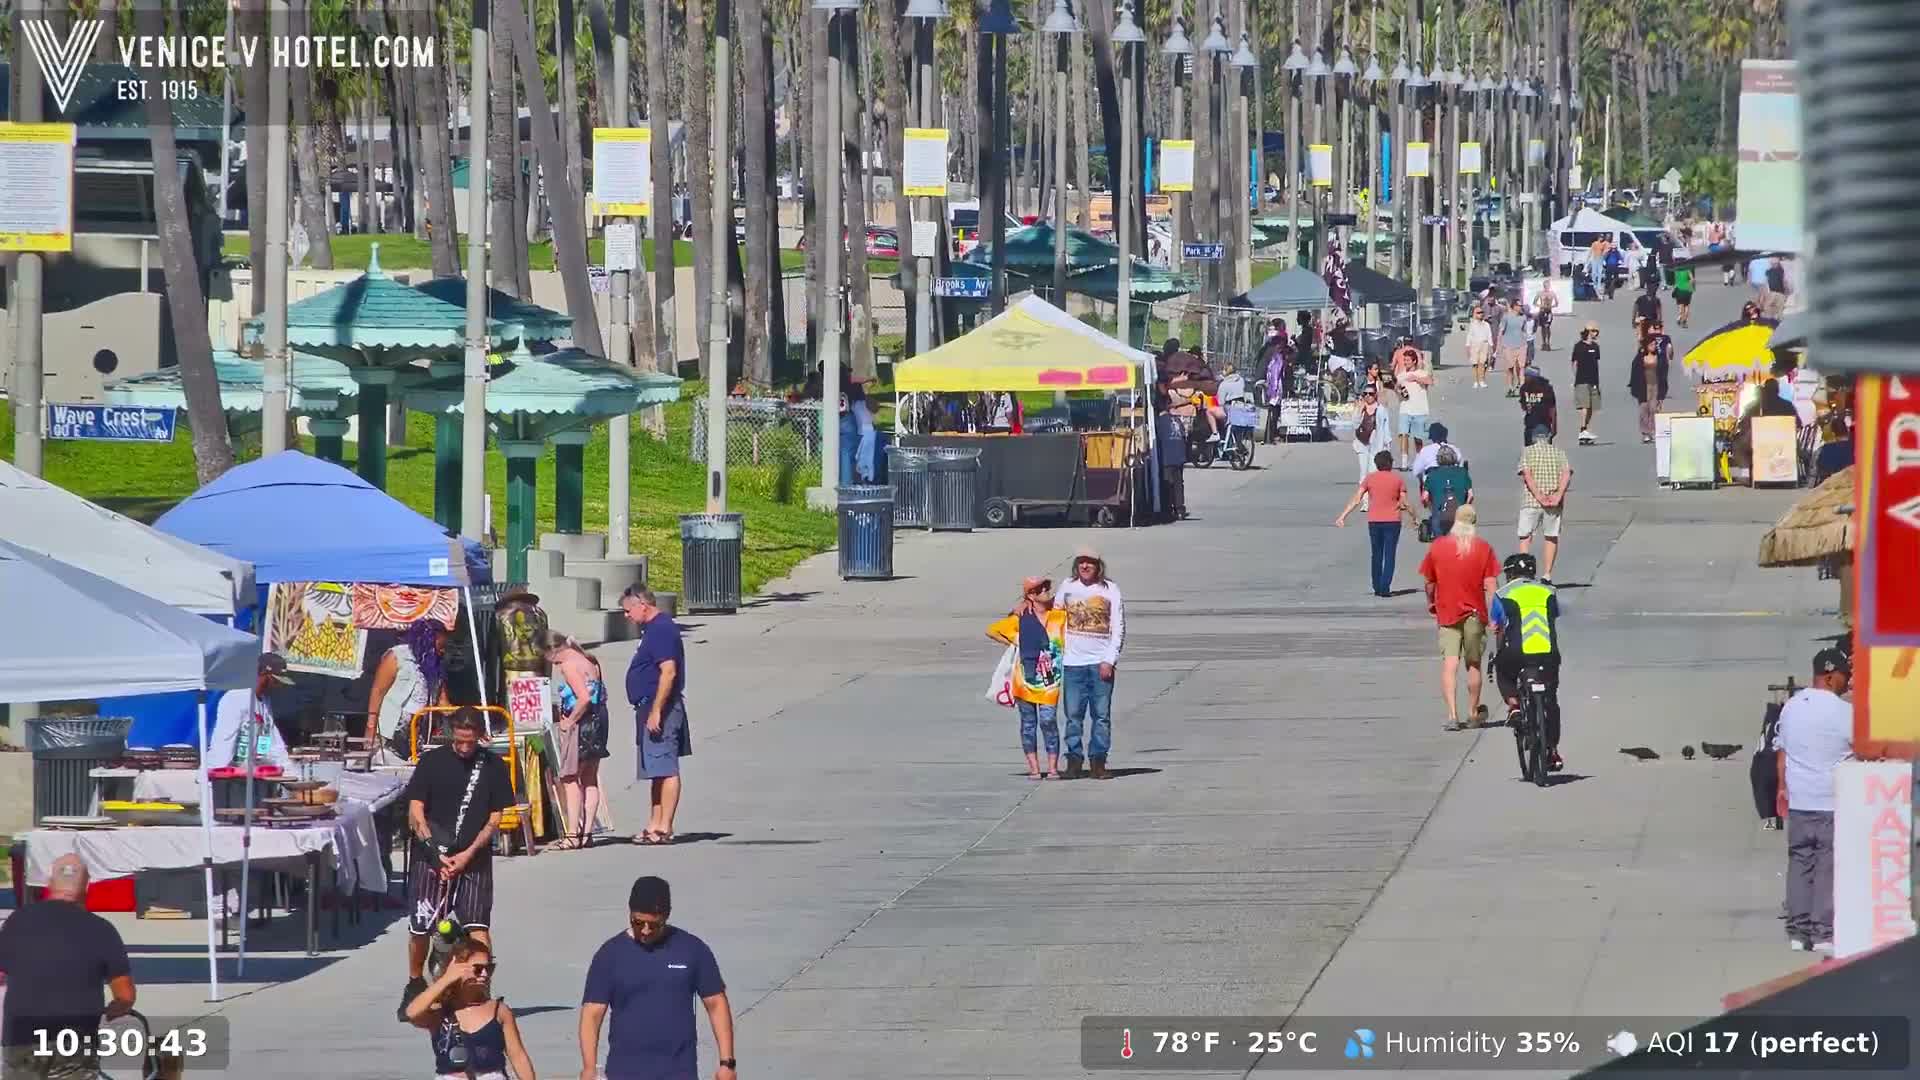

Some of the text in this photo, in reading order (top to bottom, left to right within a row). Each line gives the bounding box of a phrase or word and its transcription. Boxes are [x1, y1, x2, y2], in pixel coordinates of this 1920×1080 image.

[935, 278, 986, 289] Brooks Av
[54, 406, 96, 425] Wave
[103, 407, 146, 426] Crest
[74, 425, 81, 437] E
